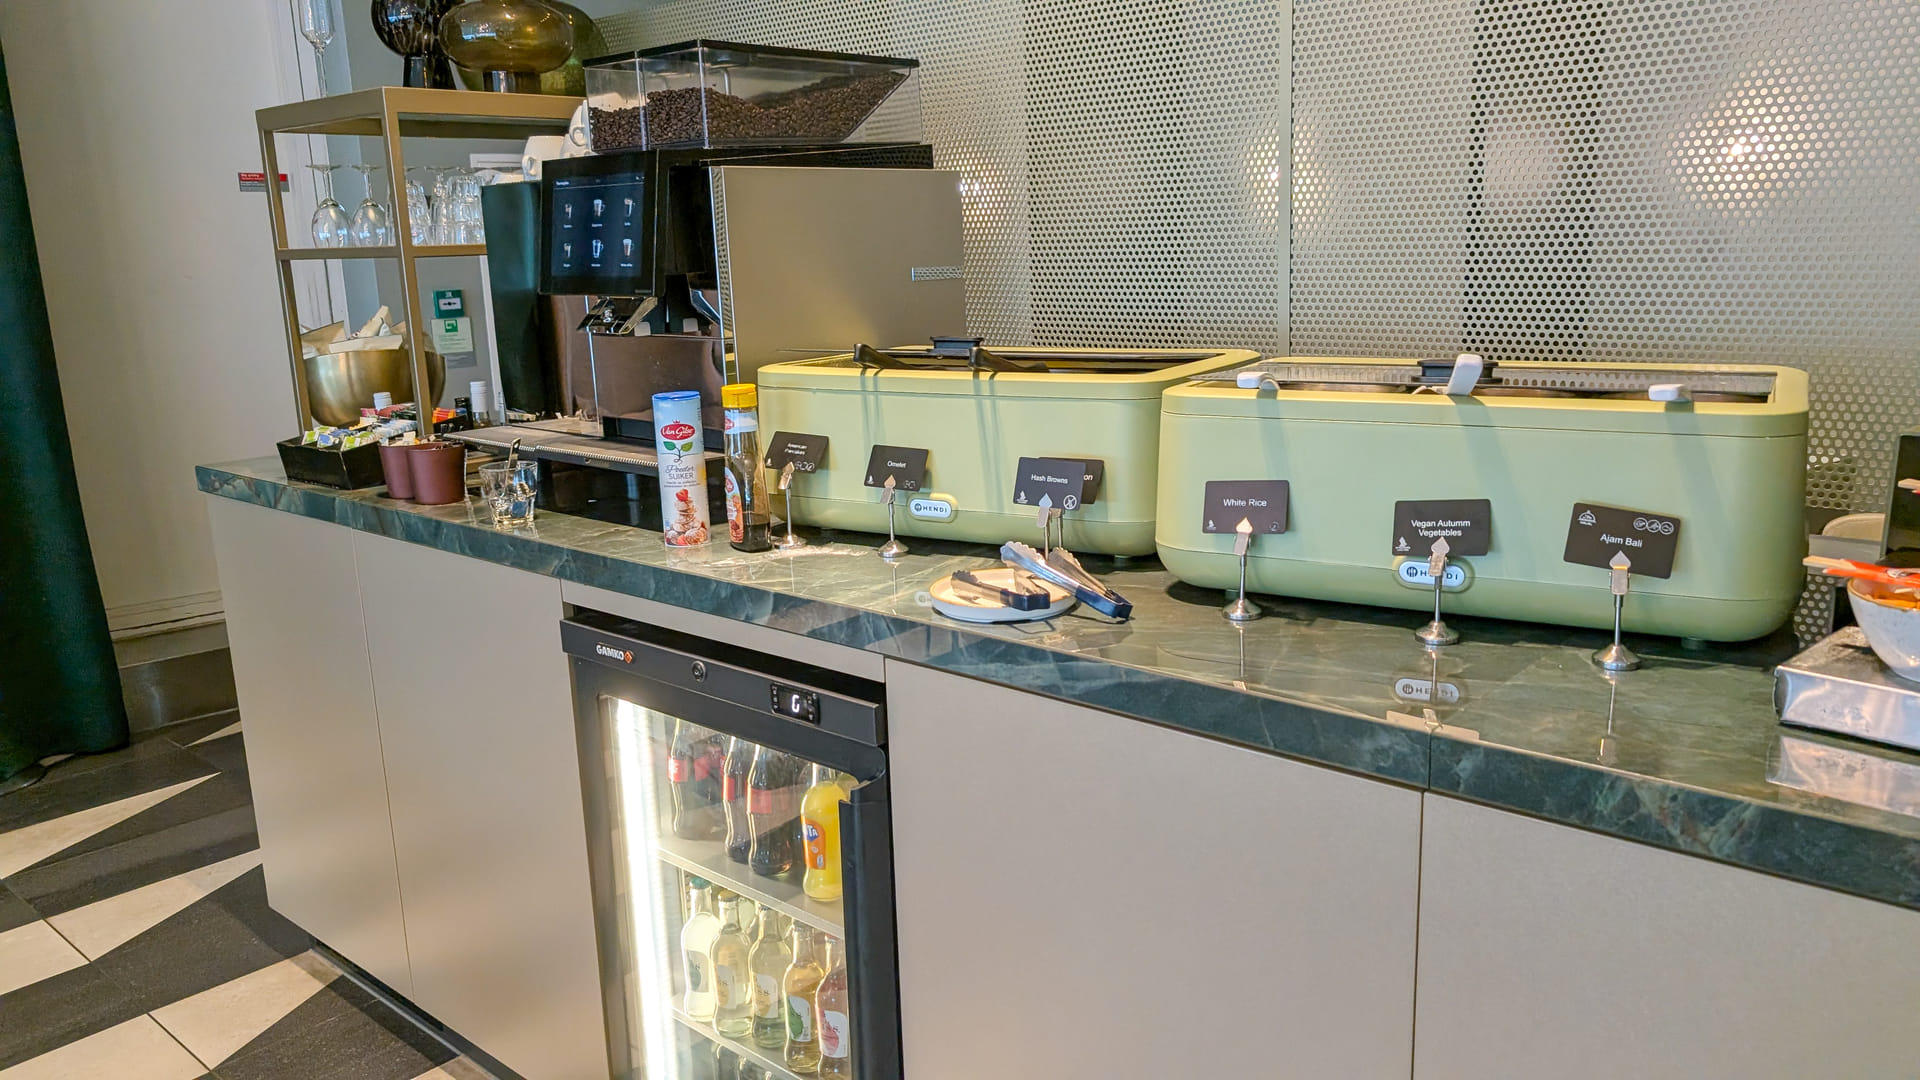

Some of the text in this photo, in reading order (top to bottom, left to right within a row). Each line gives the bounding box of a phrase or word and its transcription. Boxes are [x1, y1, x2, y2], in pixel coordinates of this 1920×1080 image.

[662, 427, 675, 435] Van
[887, 460, 907, 469] Omelet
[1031, 473, 1069, 484] Hash Browns
[1223, 498, 1268, 507] White Rice
[922, 504, 948, 513] HENDI
[1410, 519, 1436, 529] Vegan
[1418, 529, 1462, 538] Vegetables
[1600, 533, 1643, 548] Ajam Bali
[1420, 570, 1458, 580] HDI
[596, 644, 624, 661] GAMKO
